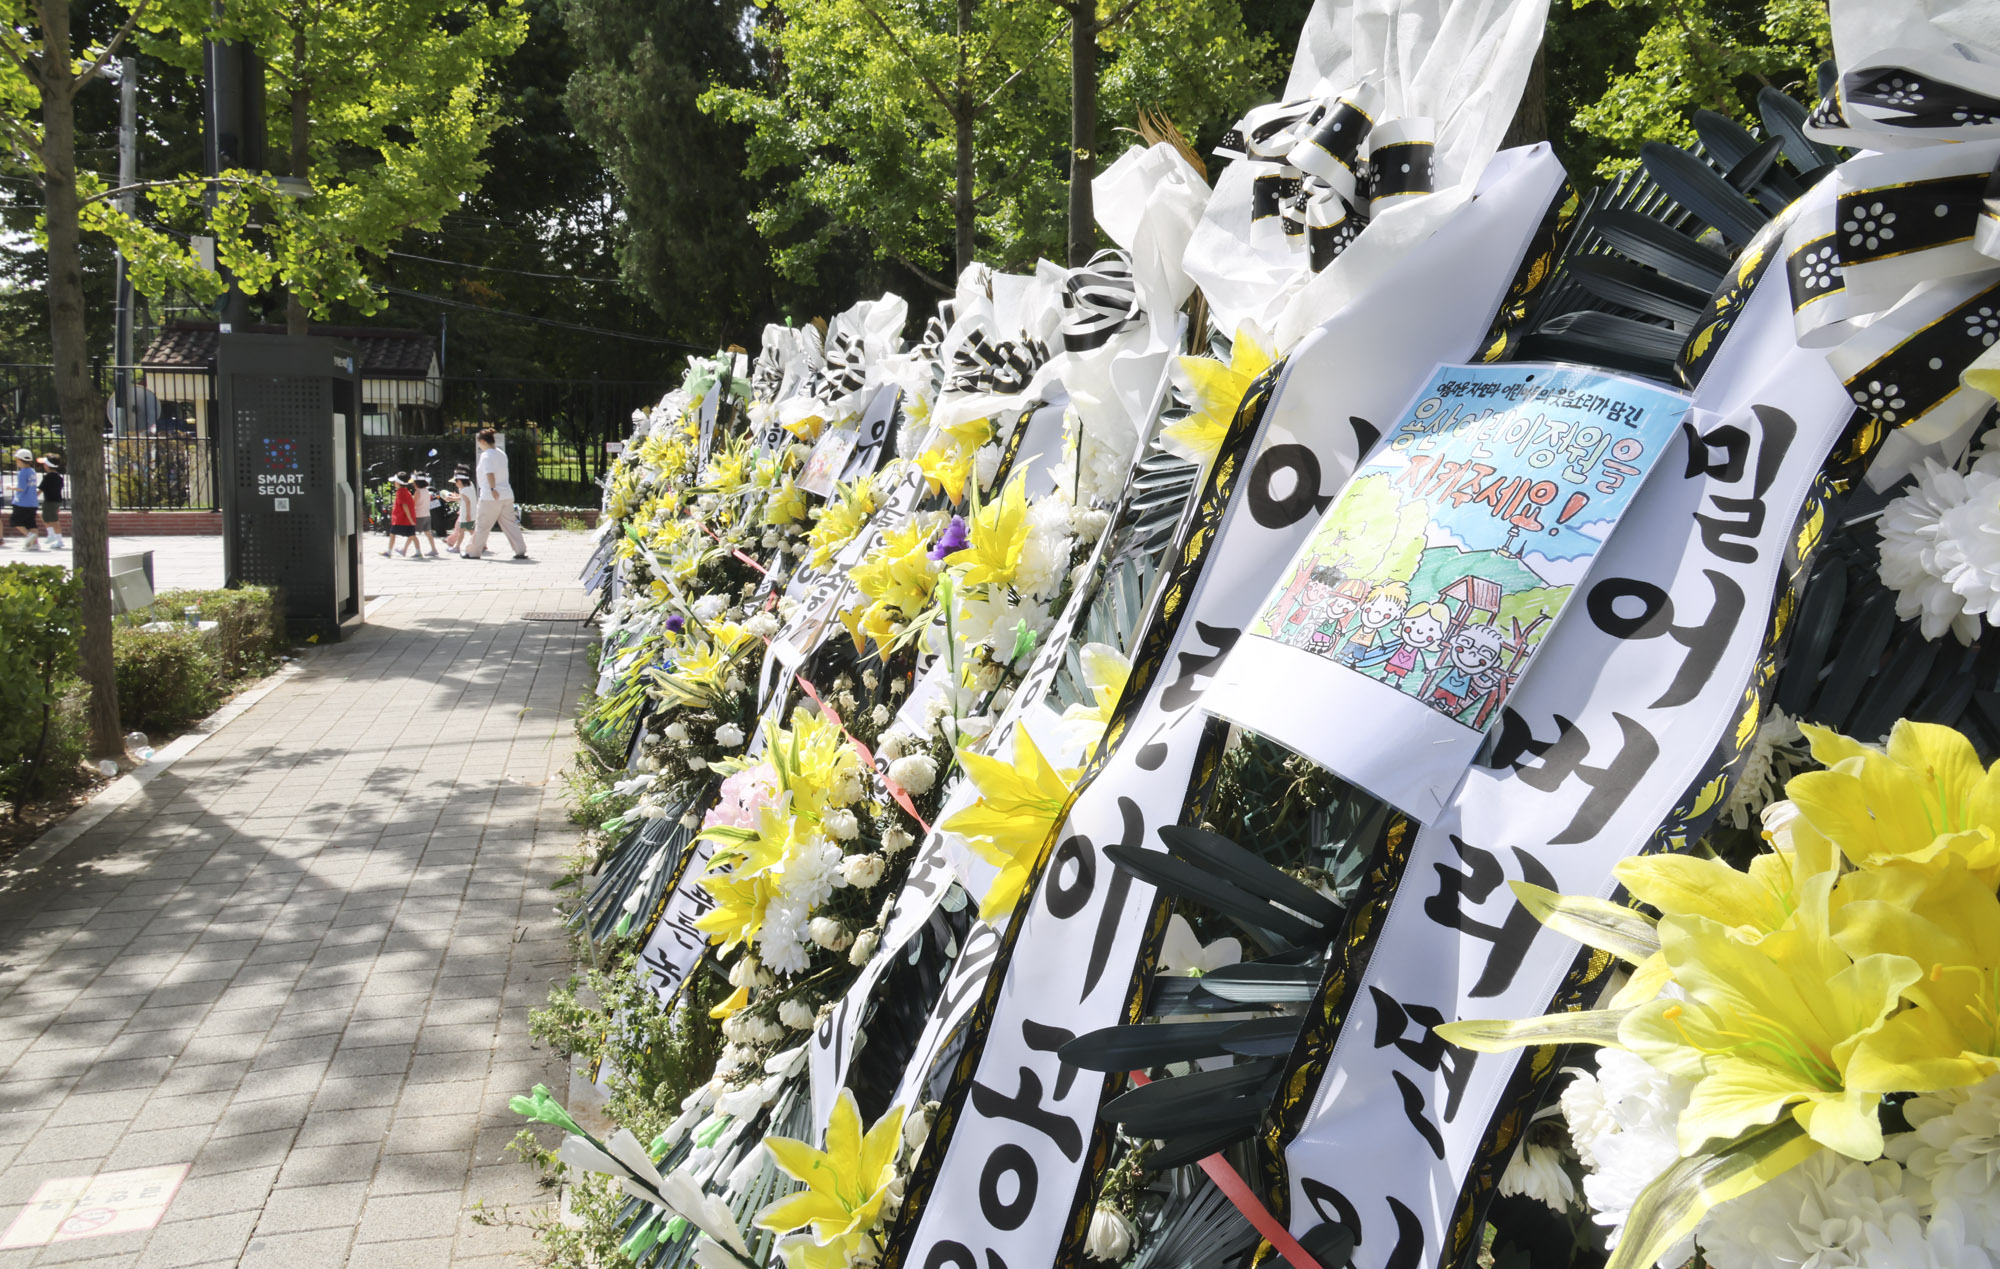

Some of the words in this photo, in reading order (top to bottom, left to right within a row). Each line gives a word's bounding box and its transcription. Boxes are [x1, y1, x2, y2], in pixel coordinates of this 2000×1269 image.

[1606, 401, 1644, 429] 담긴
[1391, 397, 1644, 494] 용산어린이정원을
[257, 474, 304, 484] SMART
